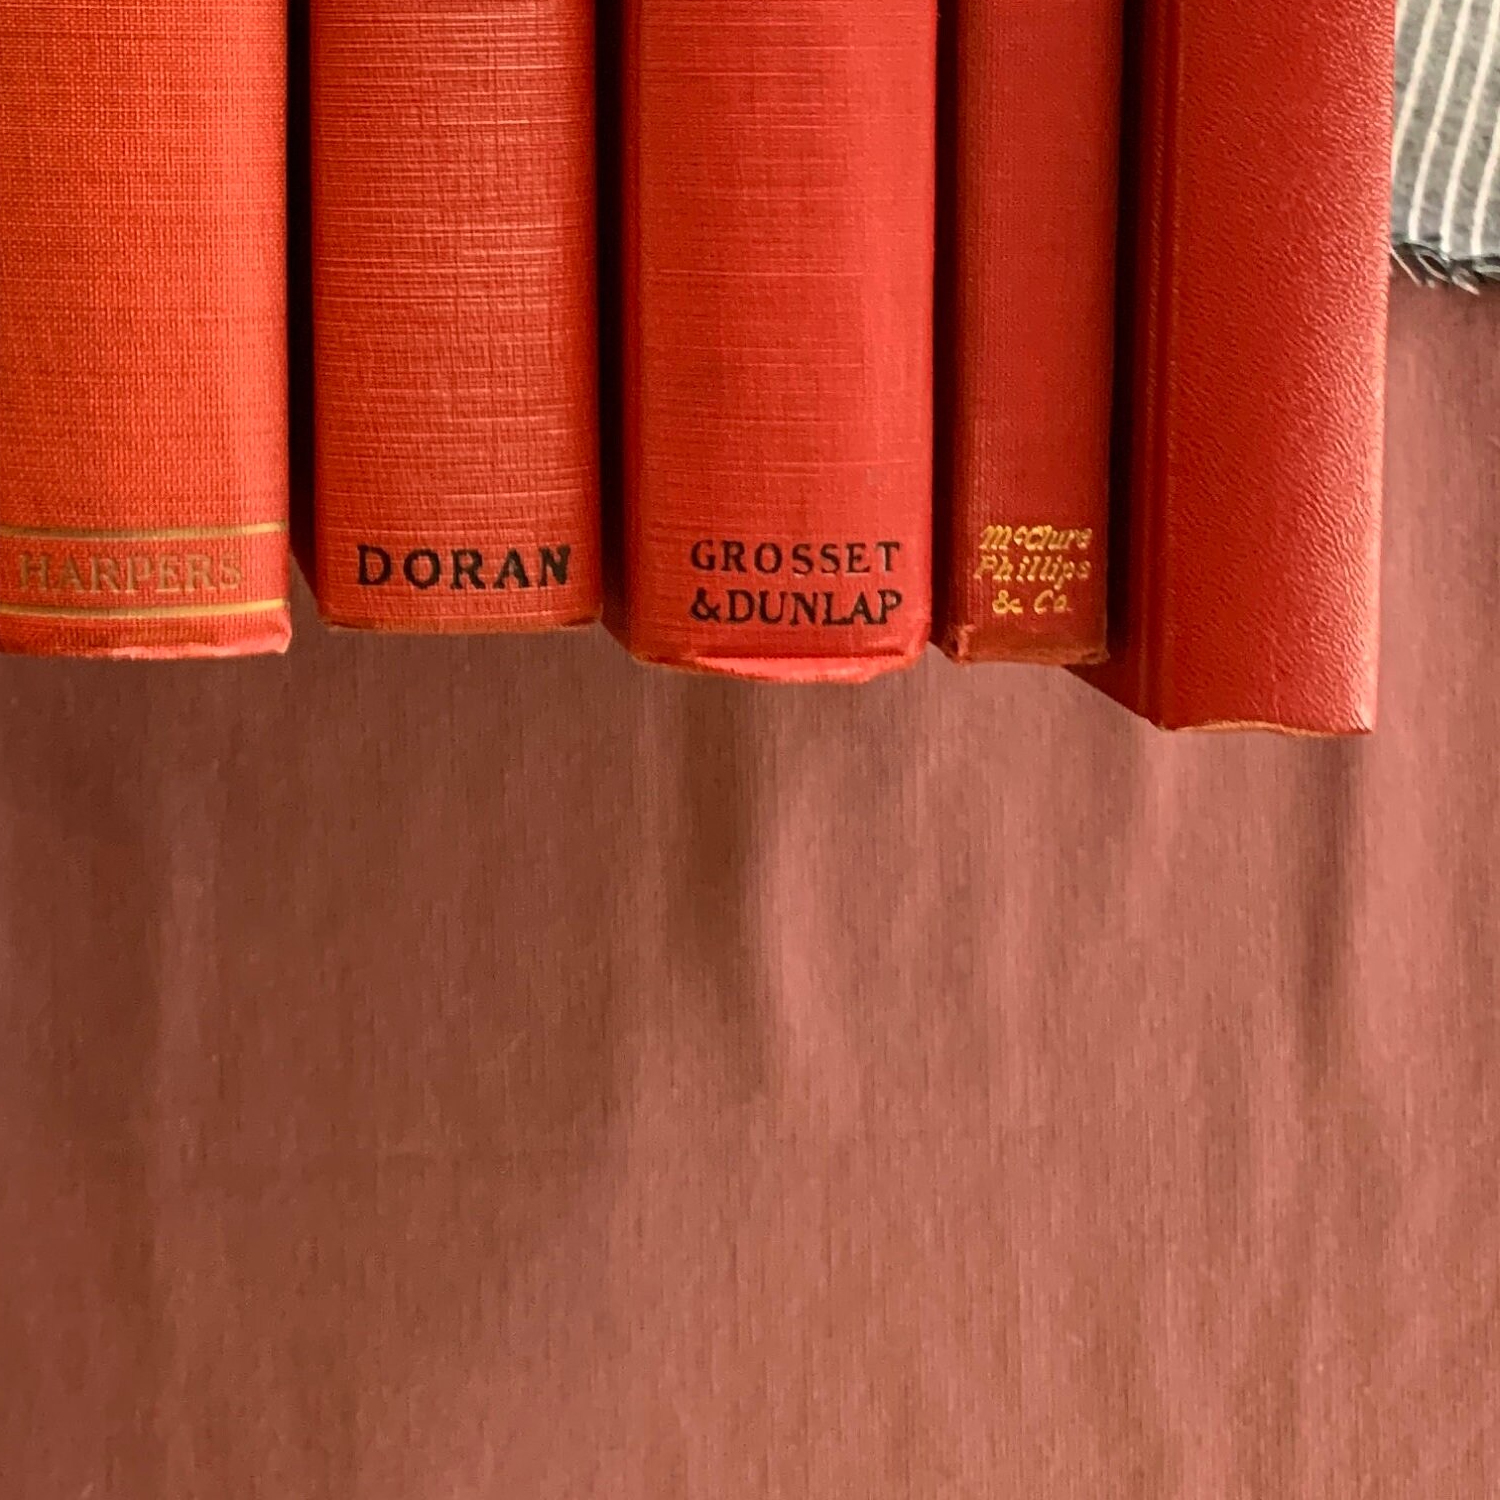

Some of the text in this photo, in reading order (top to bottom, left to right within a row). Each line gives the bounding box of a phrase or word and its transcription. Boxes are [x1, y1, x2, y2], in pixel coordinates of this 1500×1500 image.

[17, 554, 244, 595] HARPERS
[356, 544, 573, 592] DORAN
[691, 540, 902, 576] GROSSET
[974, 556, 1092, 589] Phillips
[990, 593, 1023, 615] &
